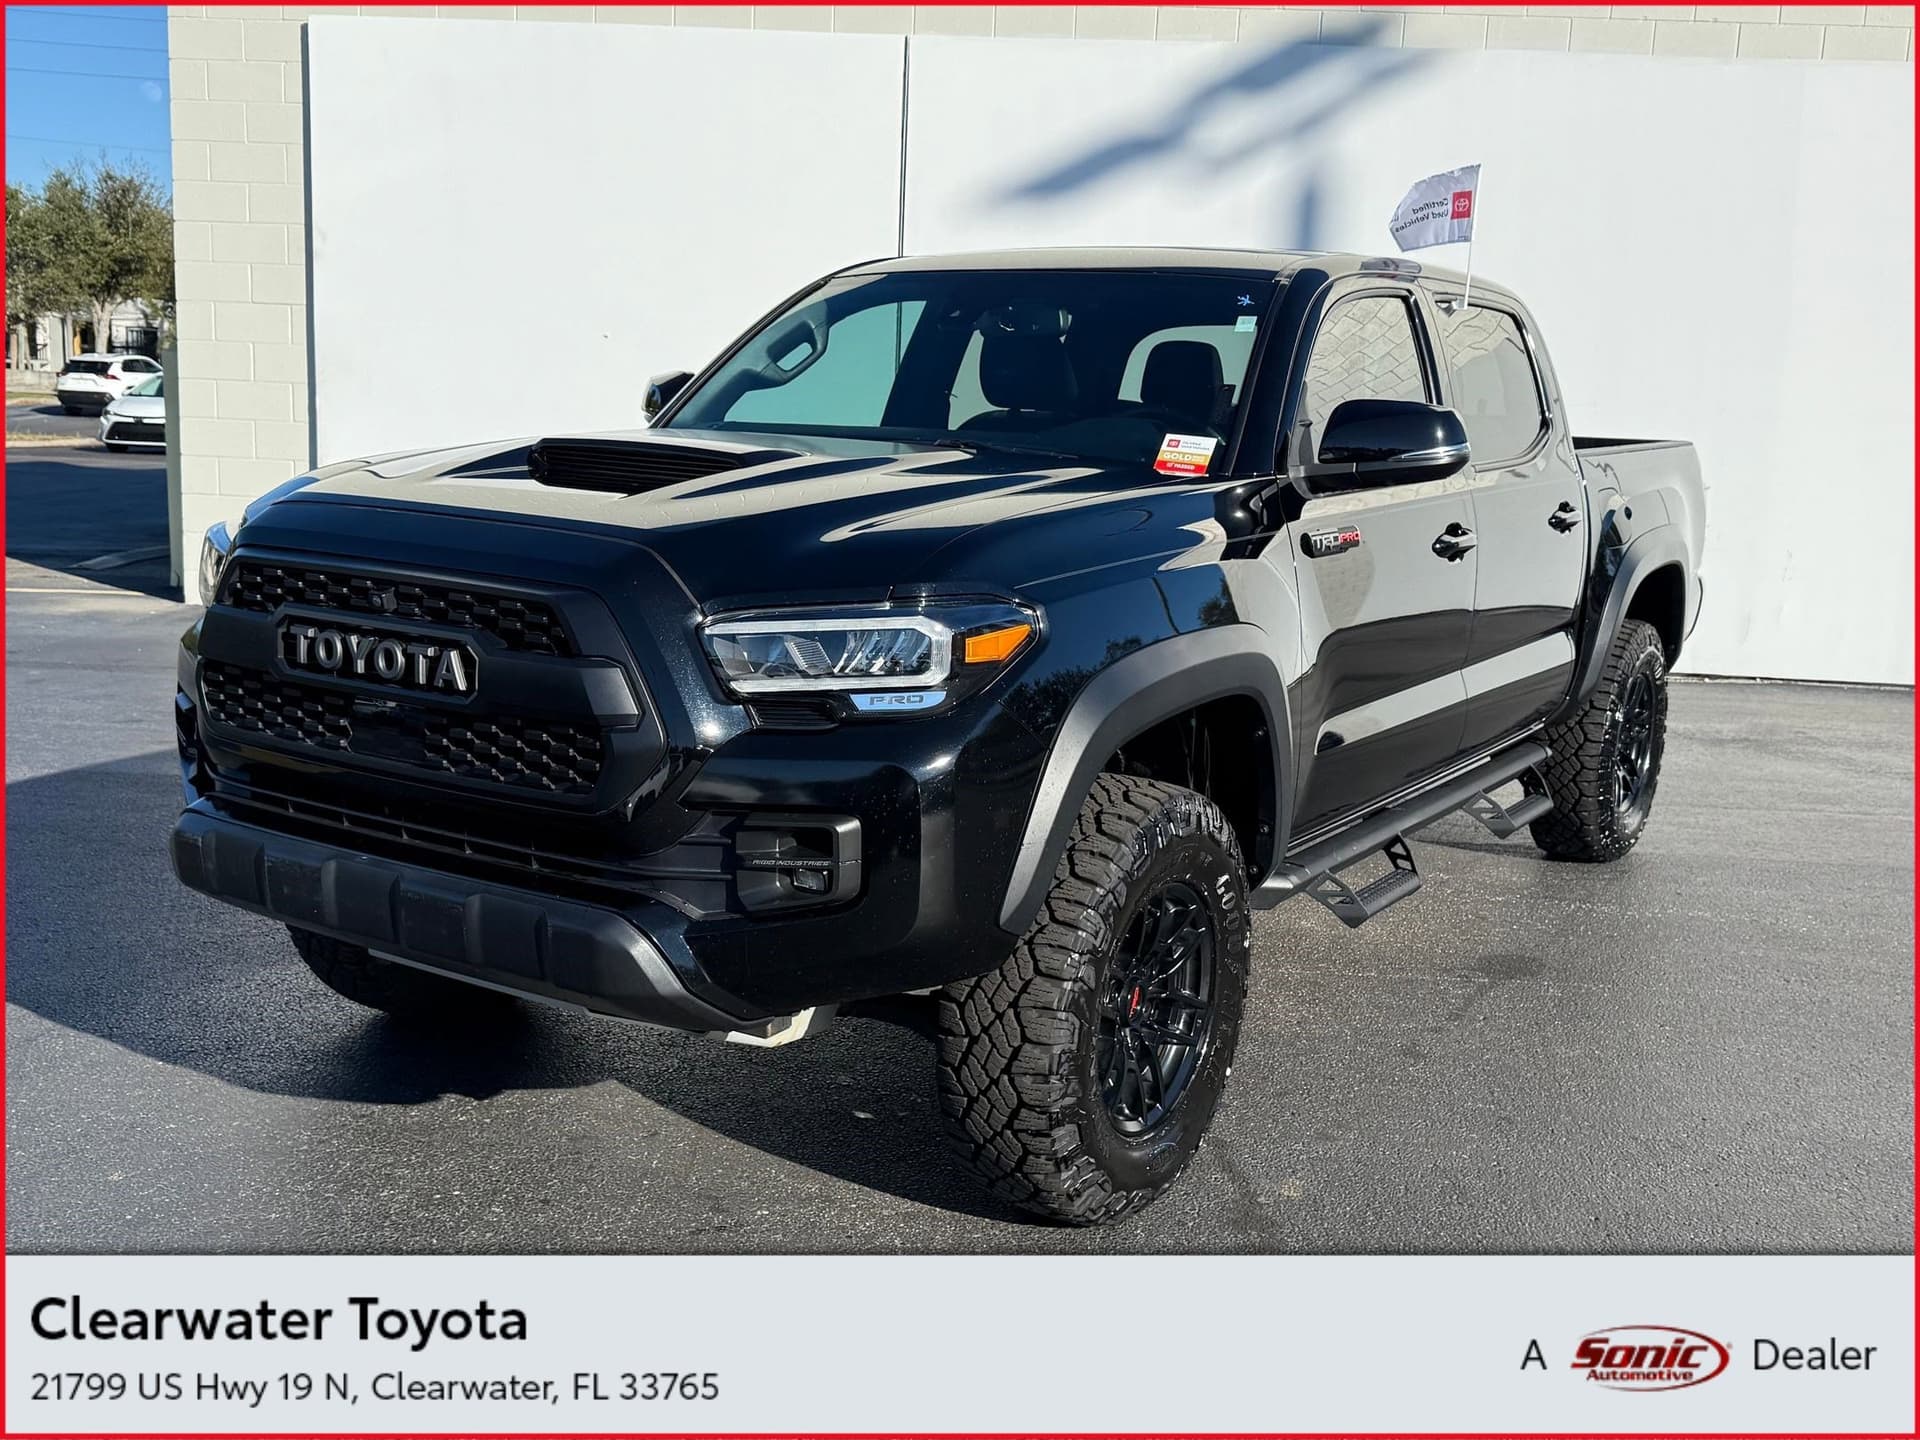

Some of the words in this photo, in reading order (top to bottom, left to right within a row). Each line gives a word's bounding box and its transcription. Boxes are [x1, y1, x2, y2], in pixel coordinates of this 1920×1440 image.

[1163, 451, 1193, 461] GOLD
[1339, 531, 1361, 545] PRO
[289, 623, 468, 691] TOYOTA
[869, 694, 924, 706] PRO
